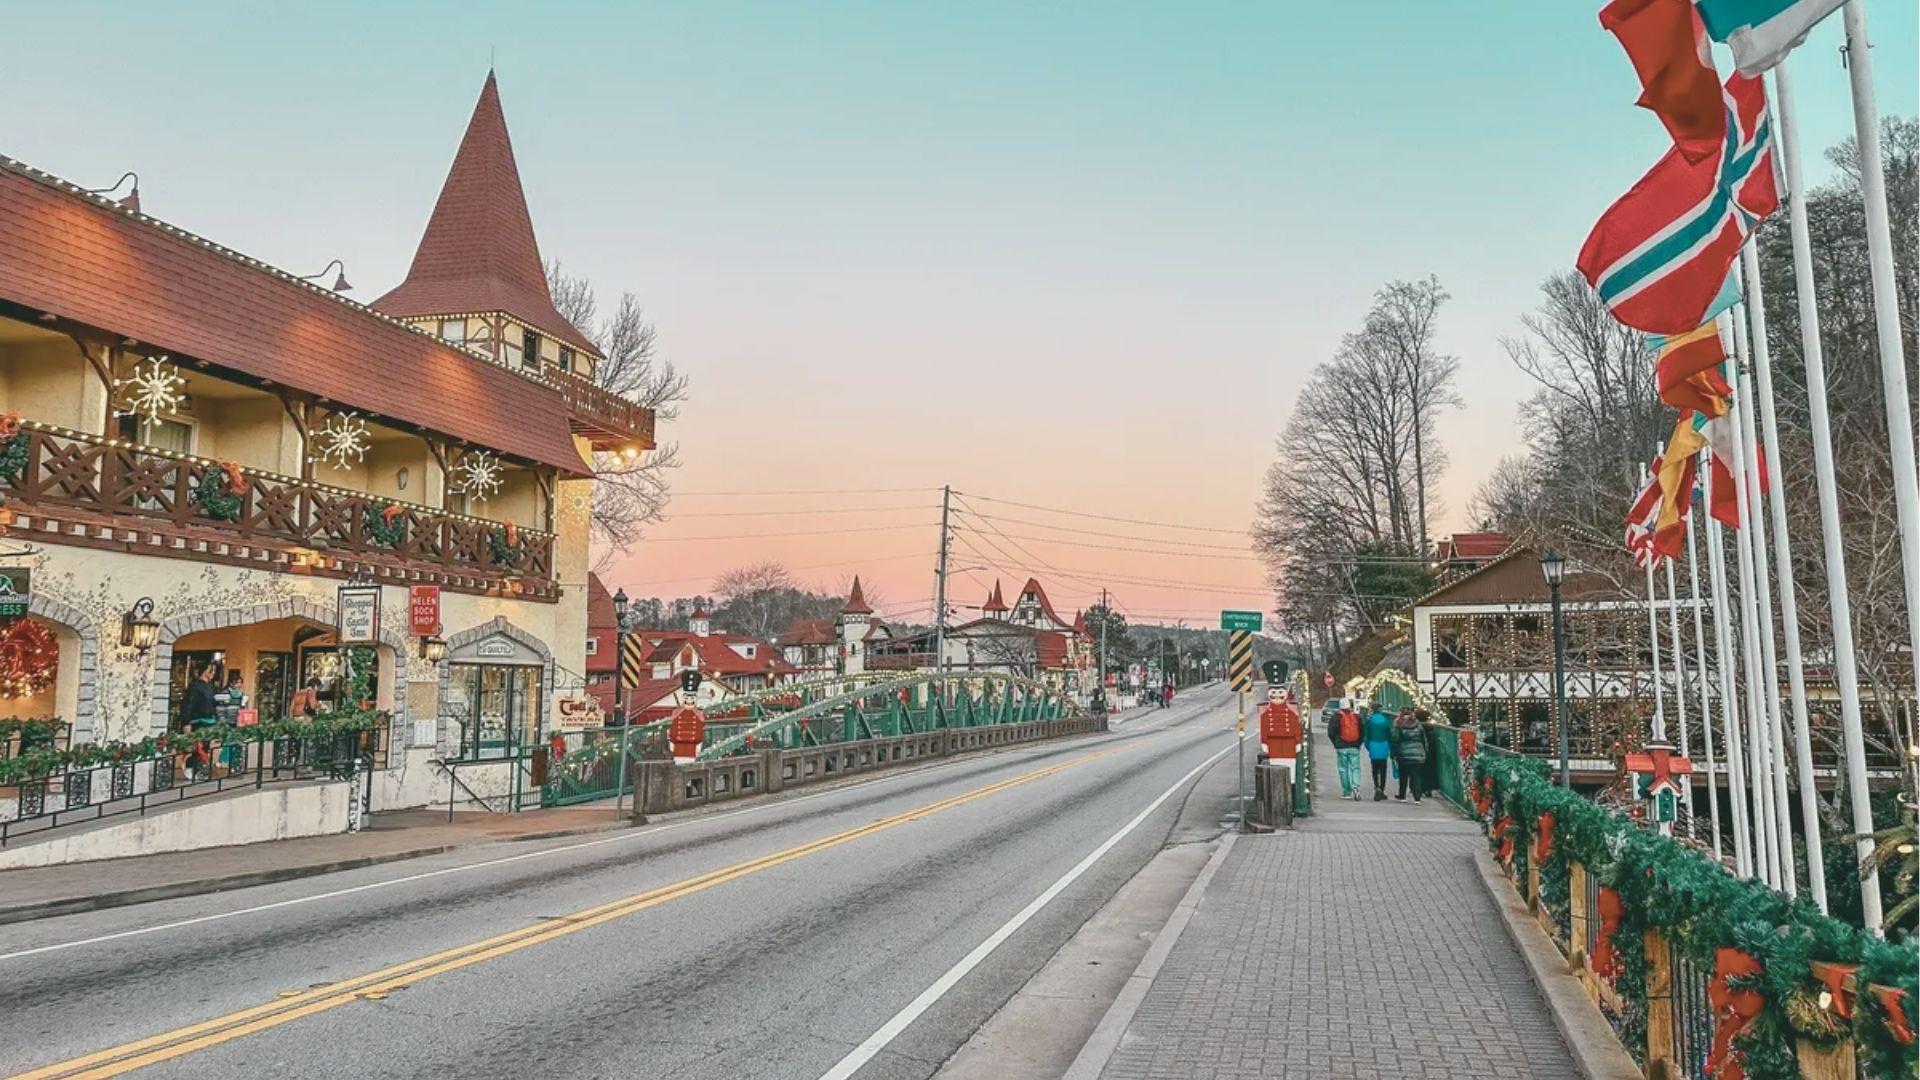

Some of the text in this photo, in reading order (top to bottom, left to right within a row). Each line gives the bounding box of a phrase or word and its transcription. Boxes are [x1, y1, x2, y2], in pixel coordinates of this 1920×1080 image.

[412, 596, 437, 605] HELEN
[413, 606, 434, 615] SOCK
[413, 615, 434, 625] SHOP
[115, 652, 142, 663] 8580
